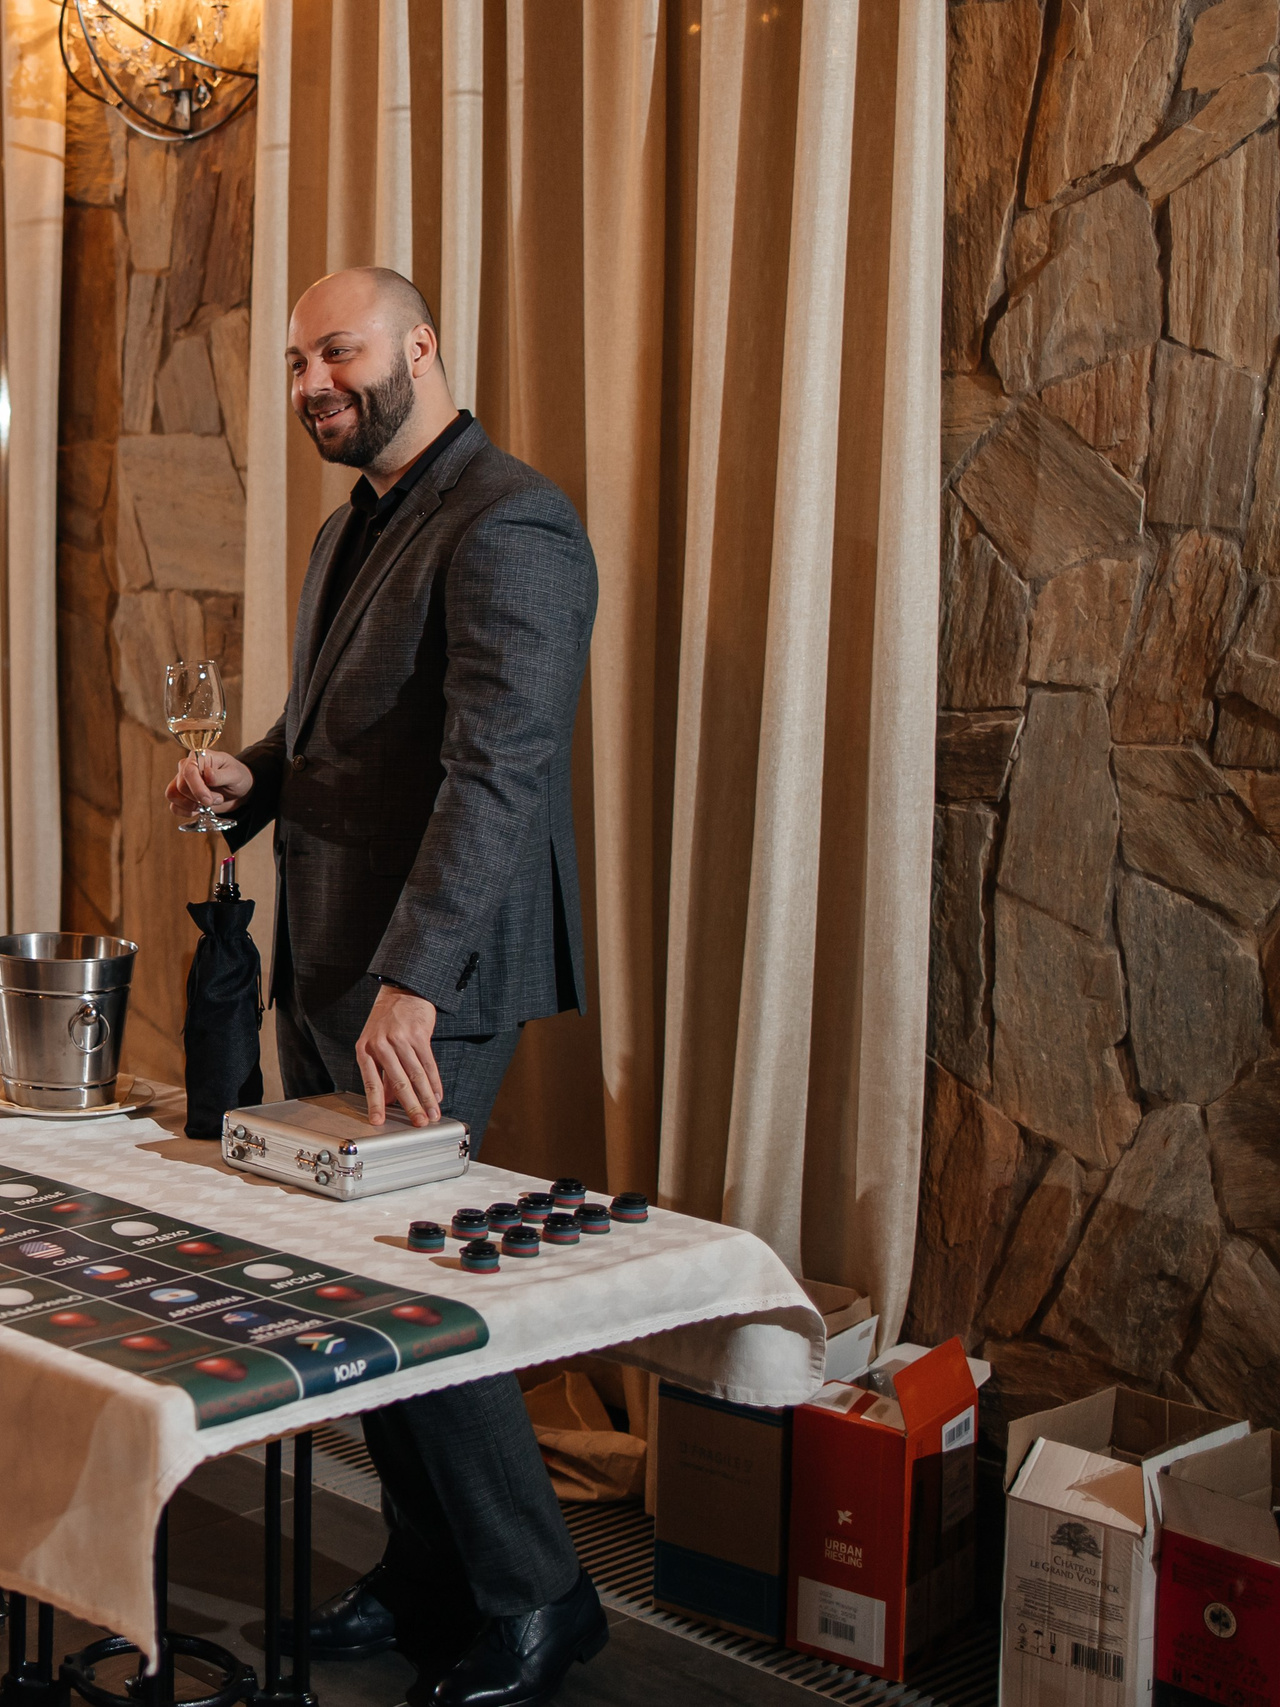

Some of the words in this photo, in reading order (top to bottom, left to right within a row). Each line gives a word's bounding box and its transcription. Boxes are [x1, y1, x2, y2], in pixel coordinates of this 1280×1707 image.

[13, 1190, 66, 1206] ВИОНЬЕ
[132, 1229, 190, 1247] ВЕРДЕХО
[52, 1254, 90, 1267] США
[115, 1276, 157, 1289] ЧИЛИ
[270, 1272, 326, 1291] МУСКАТ
[168, 1294, 246, 1319] АРГЕНТИНА
[247, 1318, 299, 1335] НОВАЯ
[334, 1360, 367, 1383] ЮАР
[824, 1537, 863, 1558] URBAN
[824, 1548, 863, 1568] RIESLING
[1030, 1559, 1040, 1570] LE
[1041, 1562, 1074, 1580] GRAND
[1076, 1572, 1120, 1594] VOSTOCK
